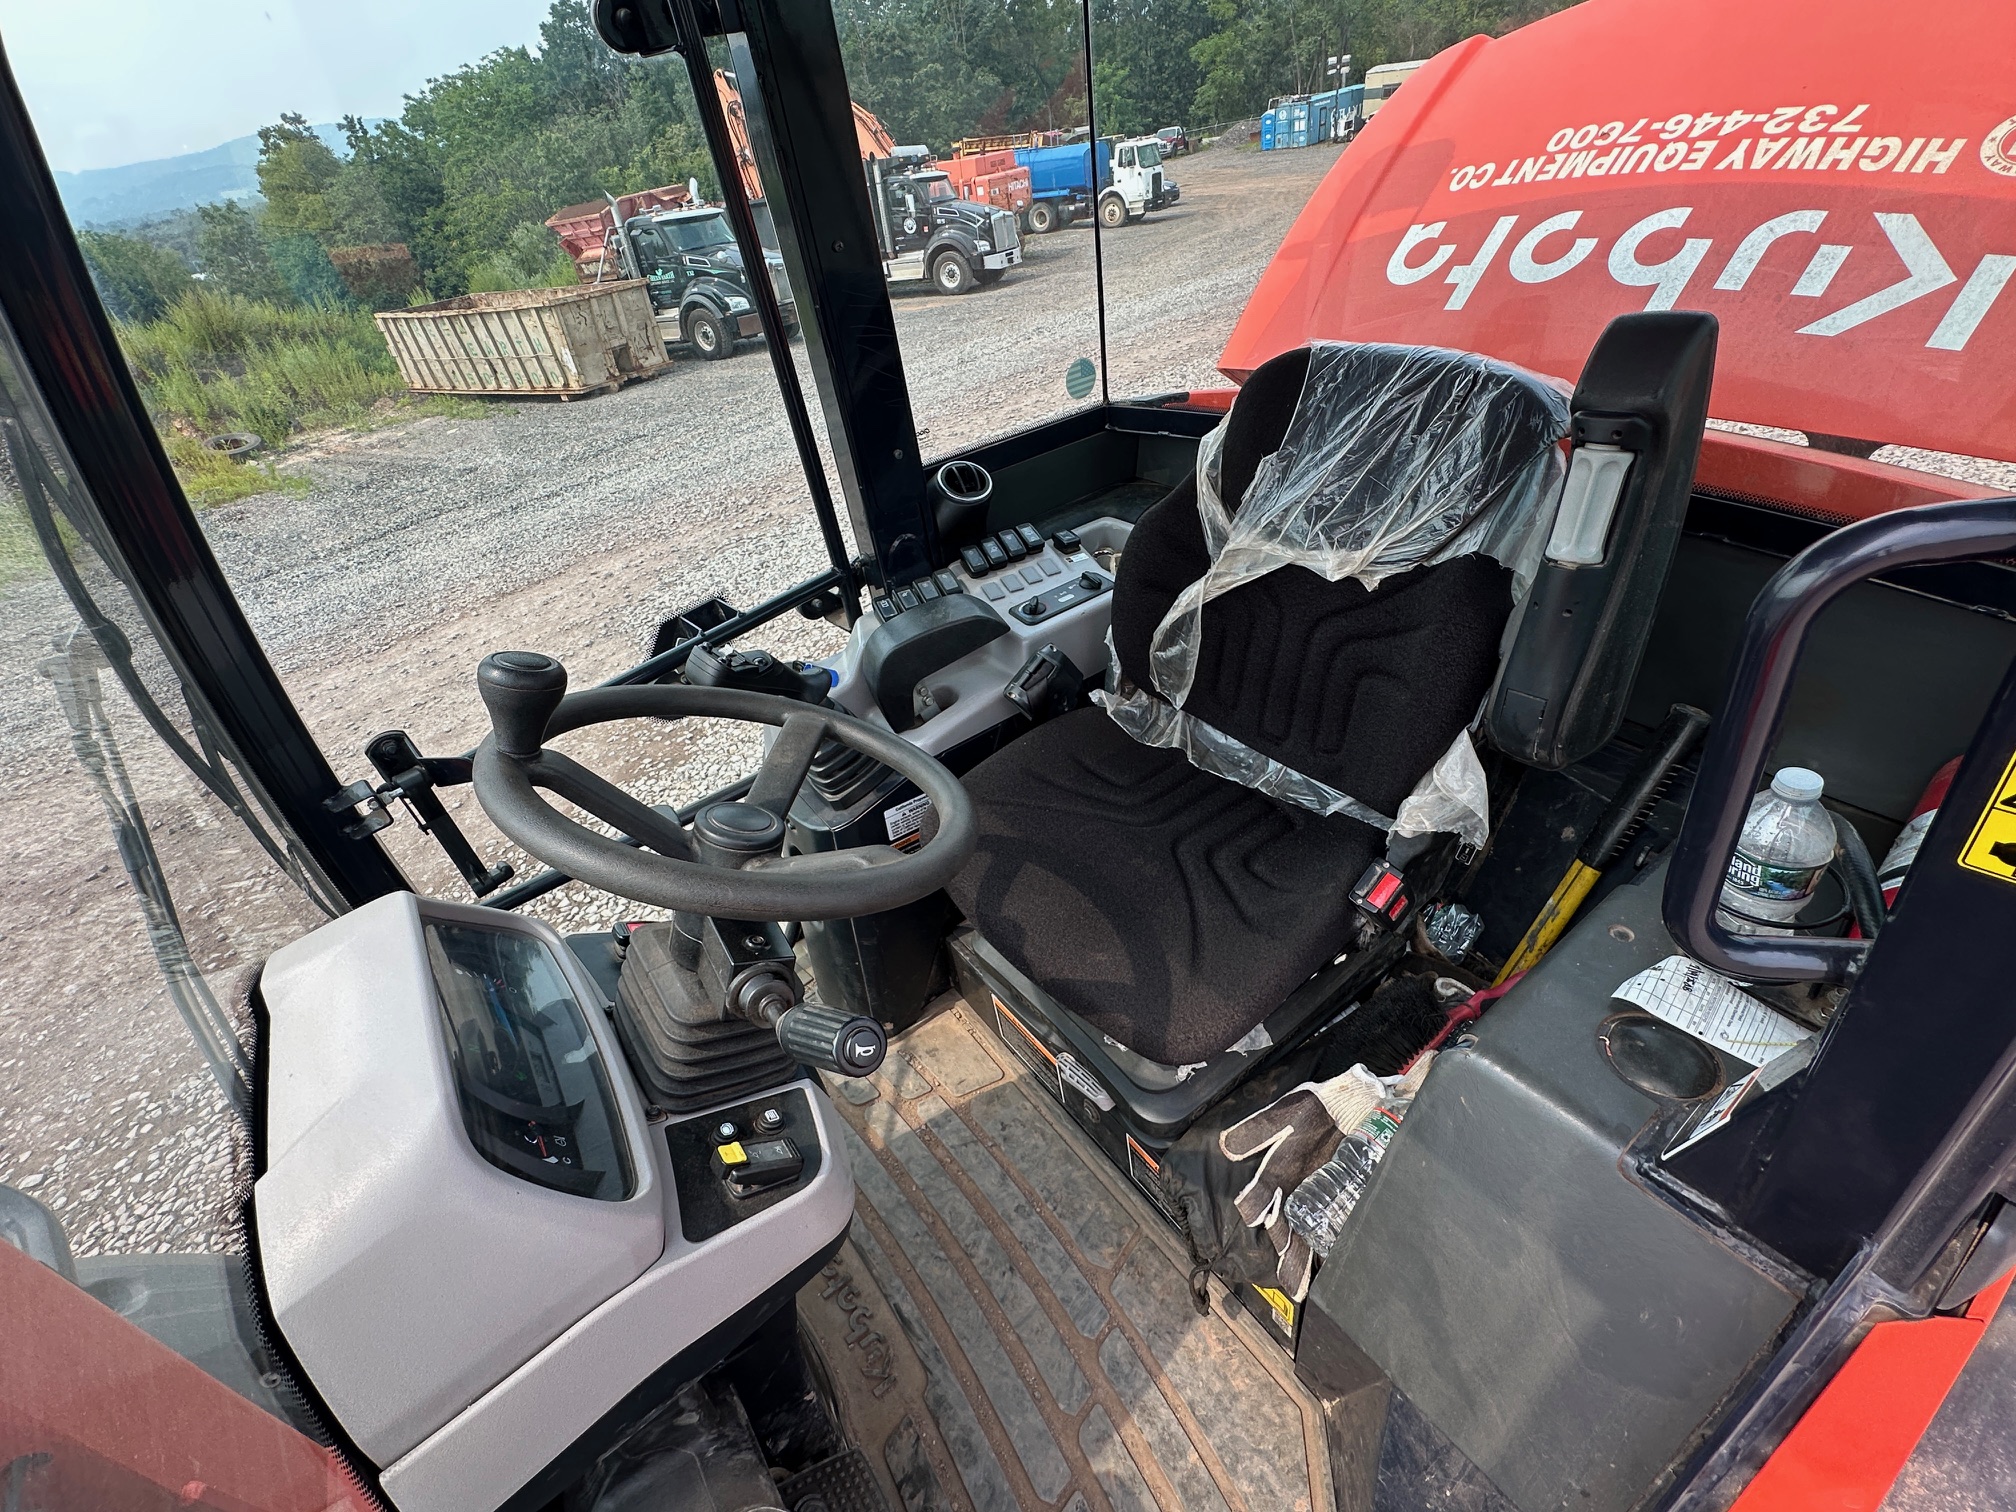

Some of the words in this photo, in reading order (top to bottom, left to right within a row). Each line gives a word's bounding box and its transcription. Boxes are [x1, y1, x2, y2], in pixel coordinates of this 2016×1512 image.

[1547, 103, 1870, 153] 732-446-7600
[1491, 139, 1719, 187] EQUIPMENT
[1714, 136, 1968, 174] HIGHWAY
[1008, 179, 1029, 191] HITACHI
[1449, 161, 1496, 192] CO.
[1386, 206, 2016, 352] Kubota
[466, 335, 545, 359] EARTH
[1728, 865, 1761, 887] ring
[1731, 855, 1761, 876] land
[820, 1253, 898, 1399] Kubota
